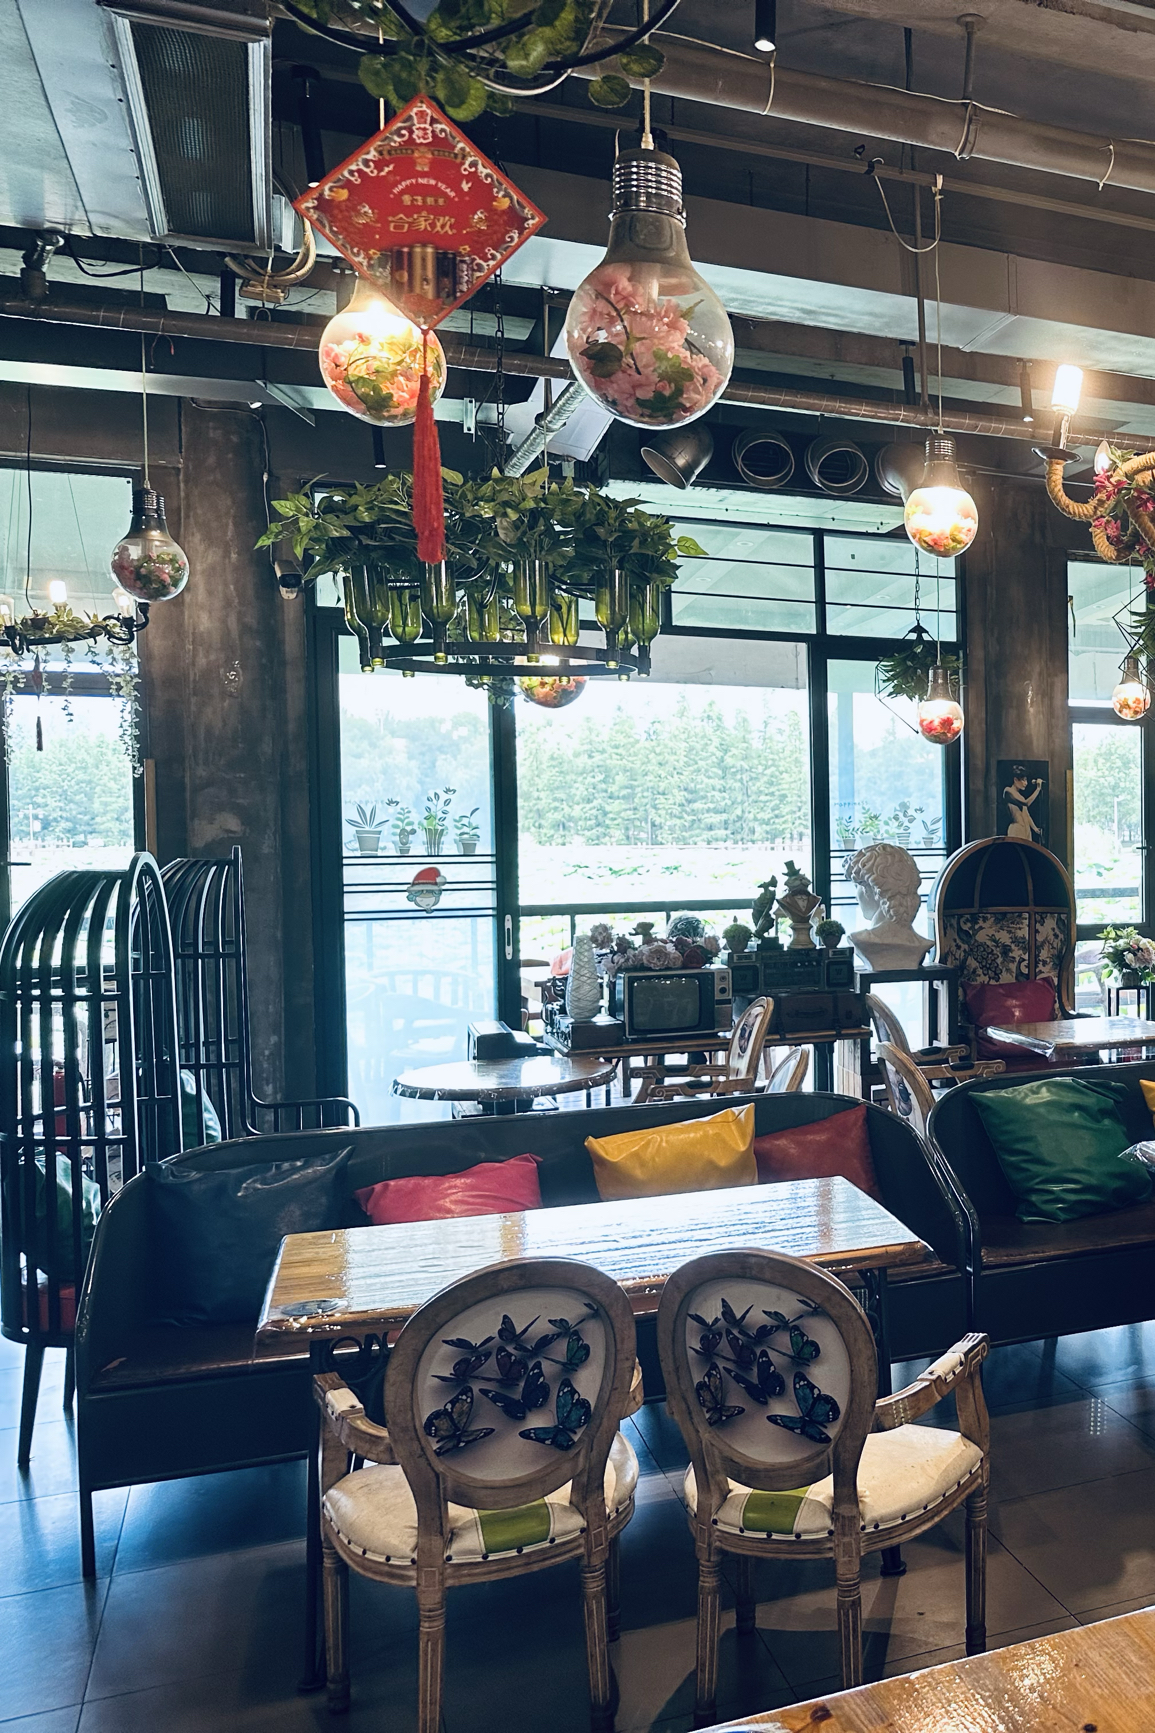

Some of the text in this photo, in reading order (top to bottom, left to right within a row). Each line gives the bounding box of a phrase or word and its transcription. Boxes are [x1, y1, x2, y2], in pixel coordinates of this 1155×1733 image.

[392, 177, 456, 198] HAPPY NEW YEAR
[388, 211, 456, 235] 合家欢
